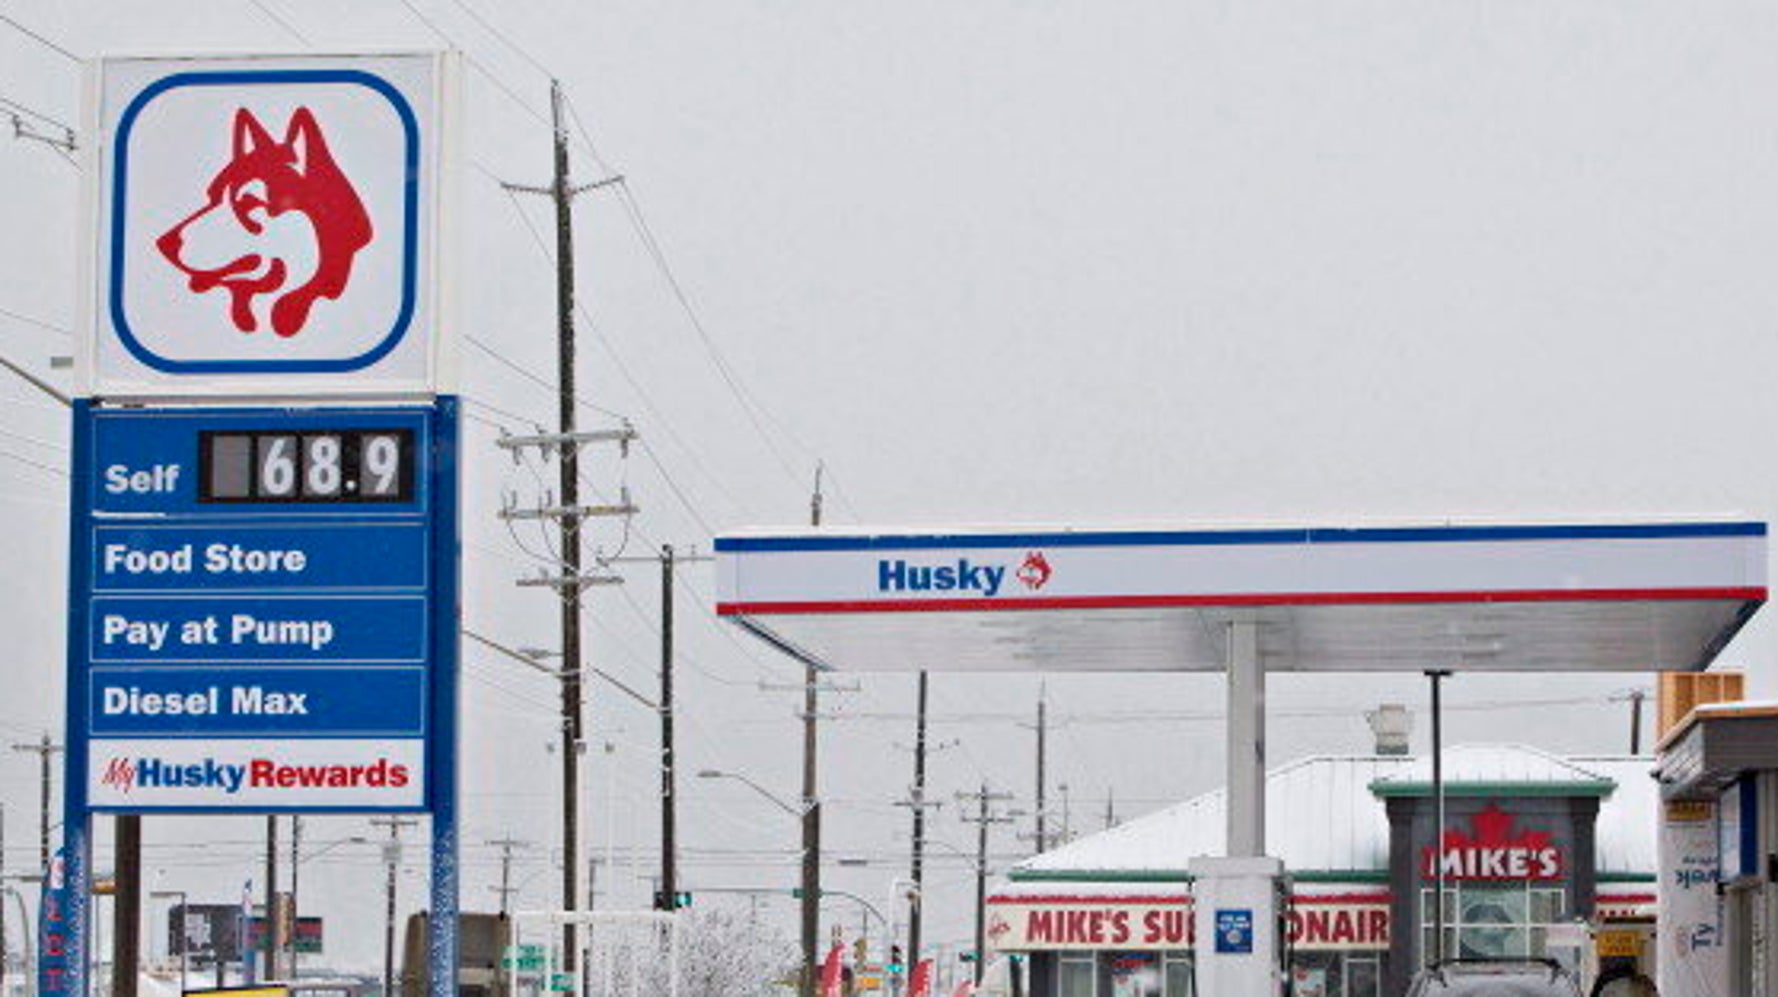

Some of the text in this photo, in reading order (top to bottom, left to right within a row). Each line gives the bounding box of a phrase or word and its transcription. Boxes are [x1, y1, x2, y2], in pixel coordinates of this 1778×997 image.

[104, 464, 180, 494] Self
[263, 435, 398, 495] 68.9
[104, 543, 307, 574] Food Store
[879, 558, 1005, 597] Husky
[103, 615, 334, 650] Pay at Pump
[103, 687, 309, 716] Diesel Max
[1429, 847, 1559, 878] MIKE'S
[1026, 910, 1131, 944] MIKE'S
